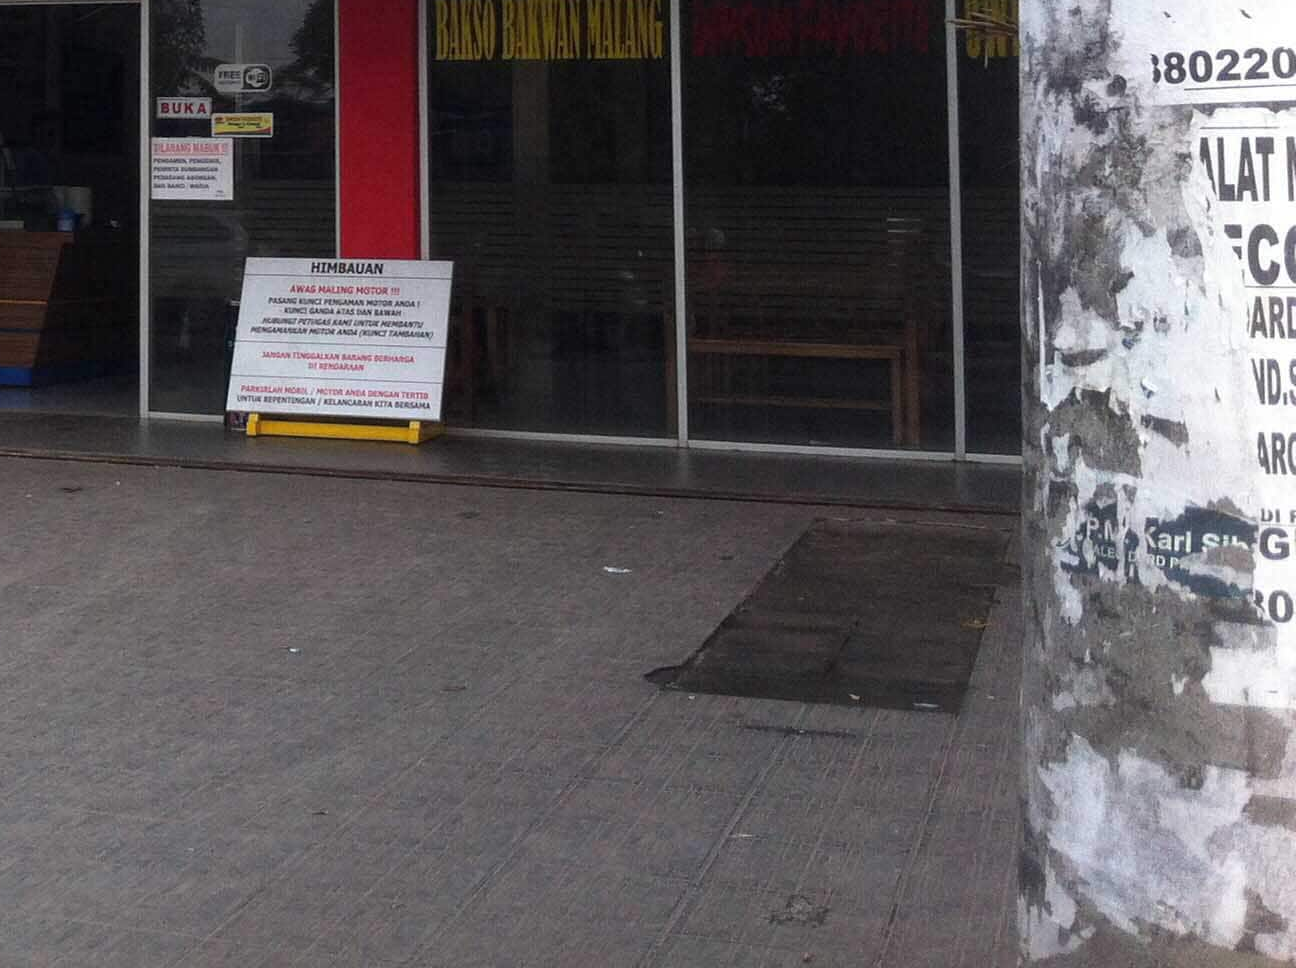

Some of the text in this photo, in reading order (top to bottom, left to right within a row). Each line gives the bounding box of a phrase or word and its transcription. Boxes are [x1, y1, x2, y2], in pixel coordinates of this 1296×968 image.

[160, 102, 207, 114] BUKA
[310, 262, 385, 275] HIMBAUAN
[317, 285, 354, 296] MALING
